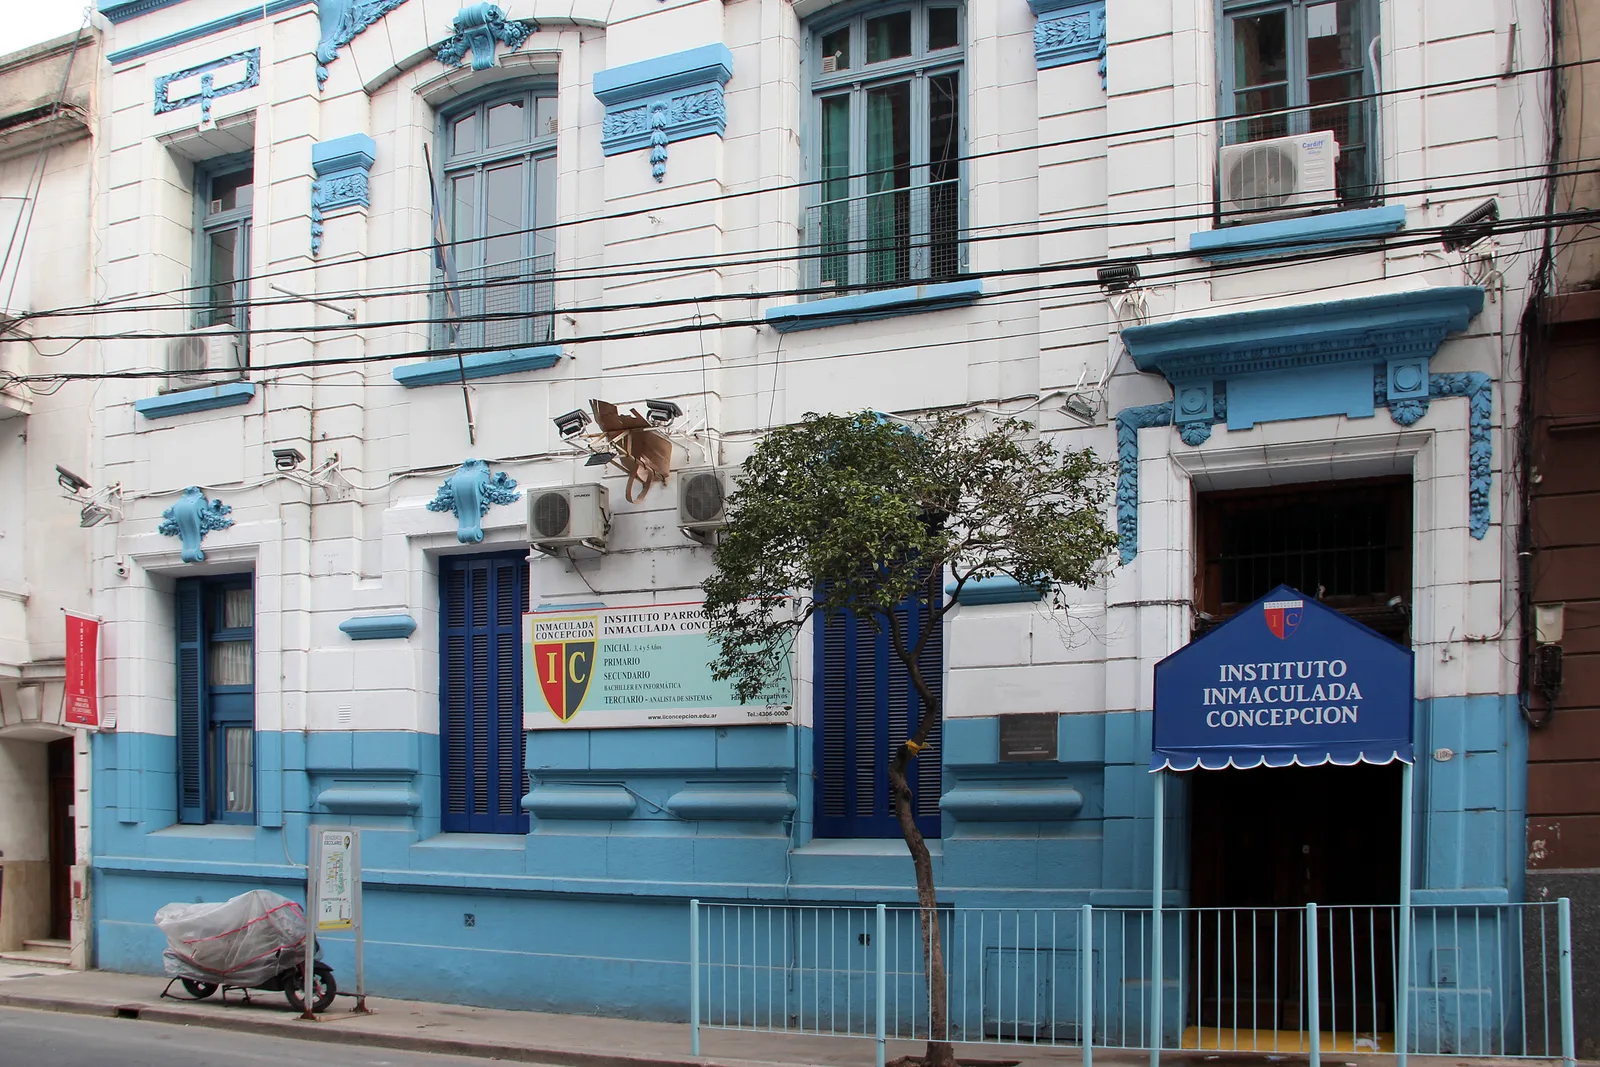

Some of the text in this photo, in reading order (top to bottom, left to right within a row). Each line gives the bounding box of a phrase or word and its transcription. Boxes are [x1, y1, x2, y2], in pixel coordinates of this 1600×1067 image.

[1302, 140, 1325, 149] Cardiff
[603, 612, 660, 623] INSTITUTO
[1271, 612, 1299, 628] I C
[536, 621, 594, 631] INMACULADA
[604, 623, 676, 634] INMACULADA
[536, 629, 594, 640] CONCEPCION
[604, 643, 631, 653] INICIAL
[546, 651, 586, 684] I C
[604, 657, 641, 667] PRIMARIO
[604, 670, 651, 680] SECUNDARIO
[1219, 659, 1348, 682] INSTITUTO
[643, 681, 682, 690] INFORMÁTICA
[604, 695, 644, 704] TERCIARIO
[685, 694, 713, 702] SISTEMAS
[1203, 682, 1363, 706] INMACULADA
[1206, 705, 1359, 728] CONCEPCION
